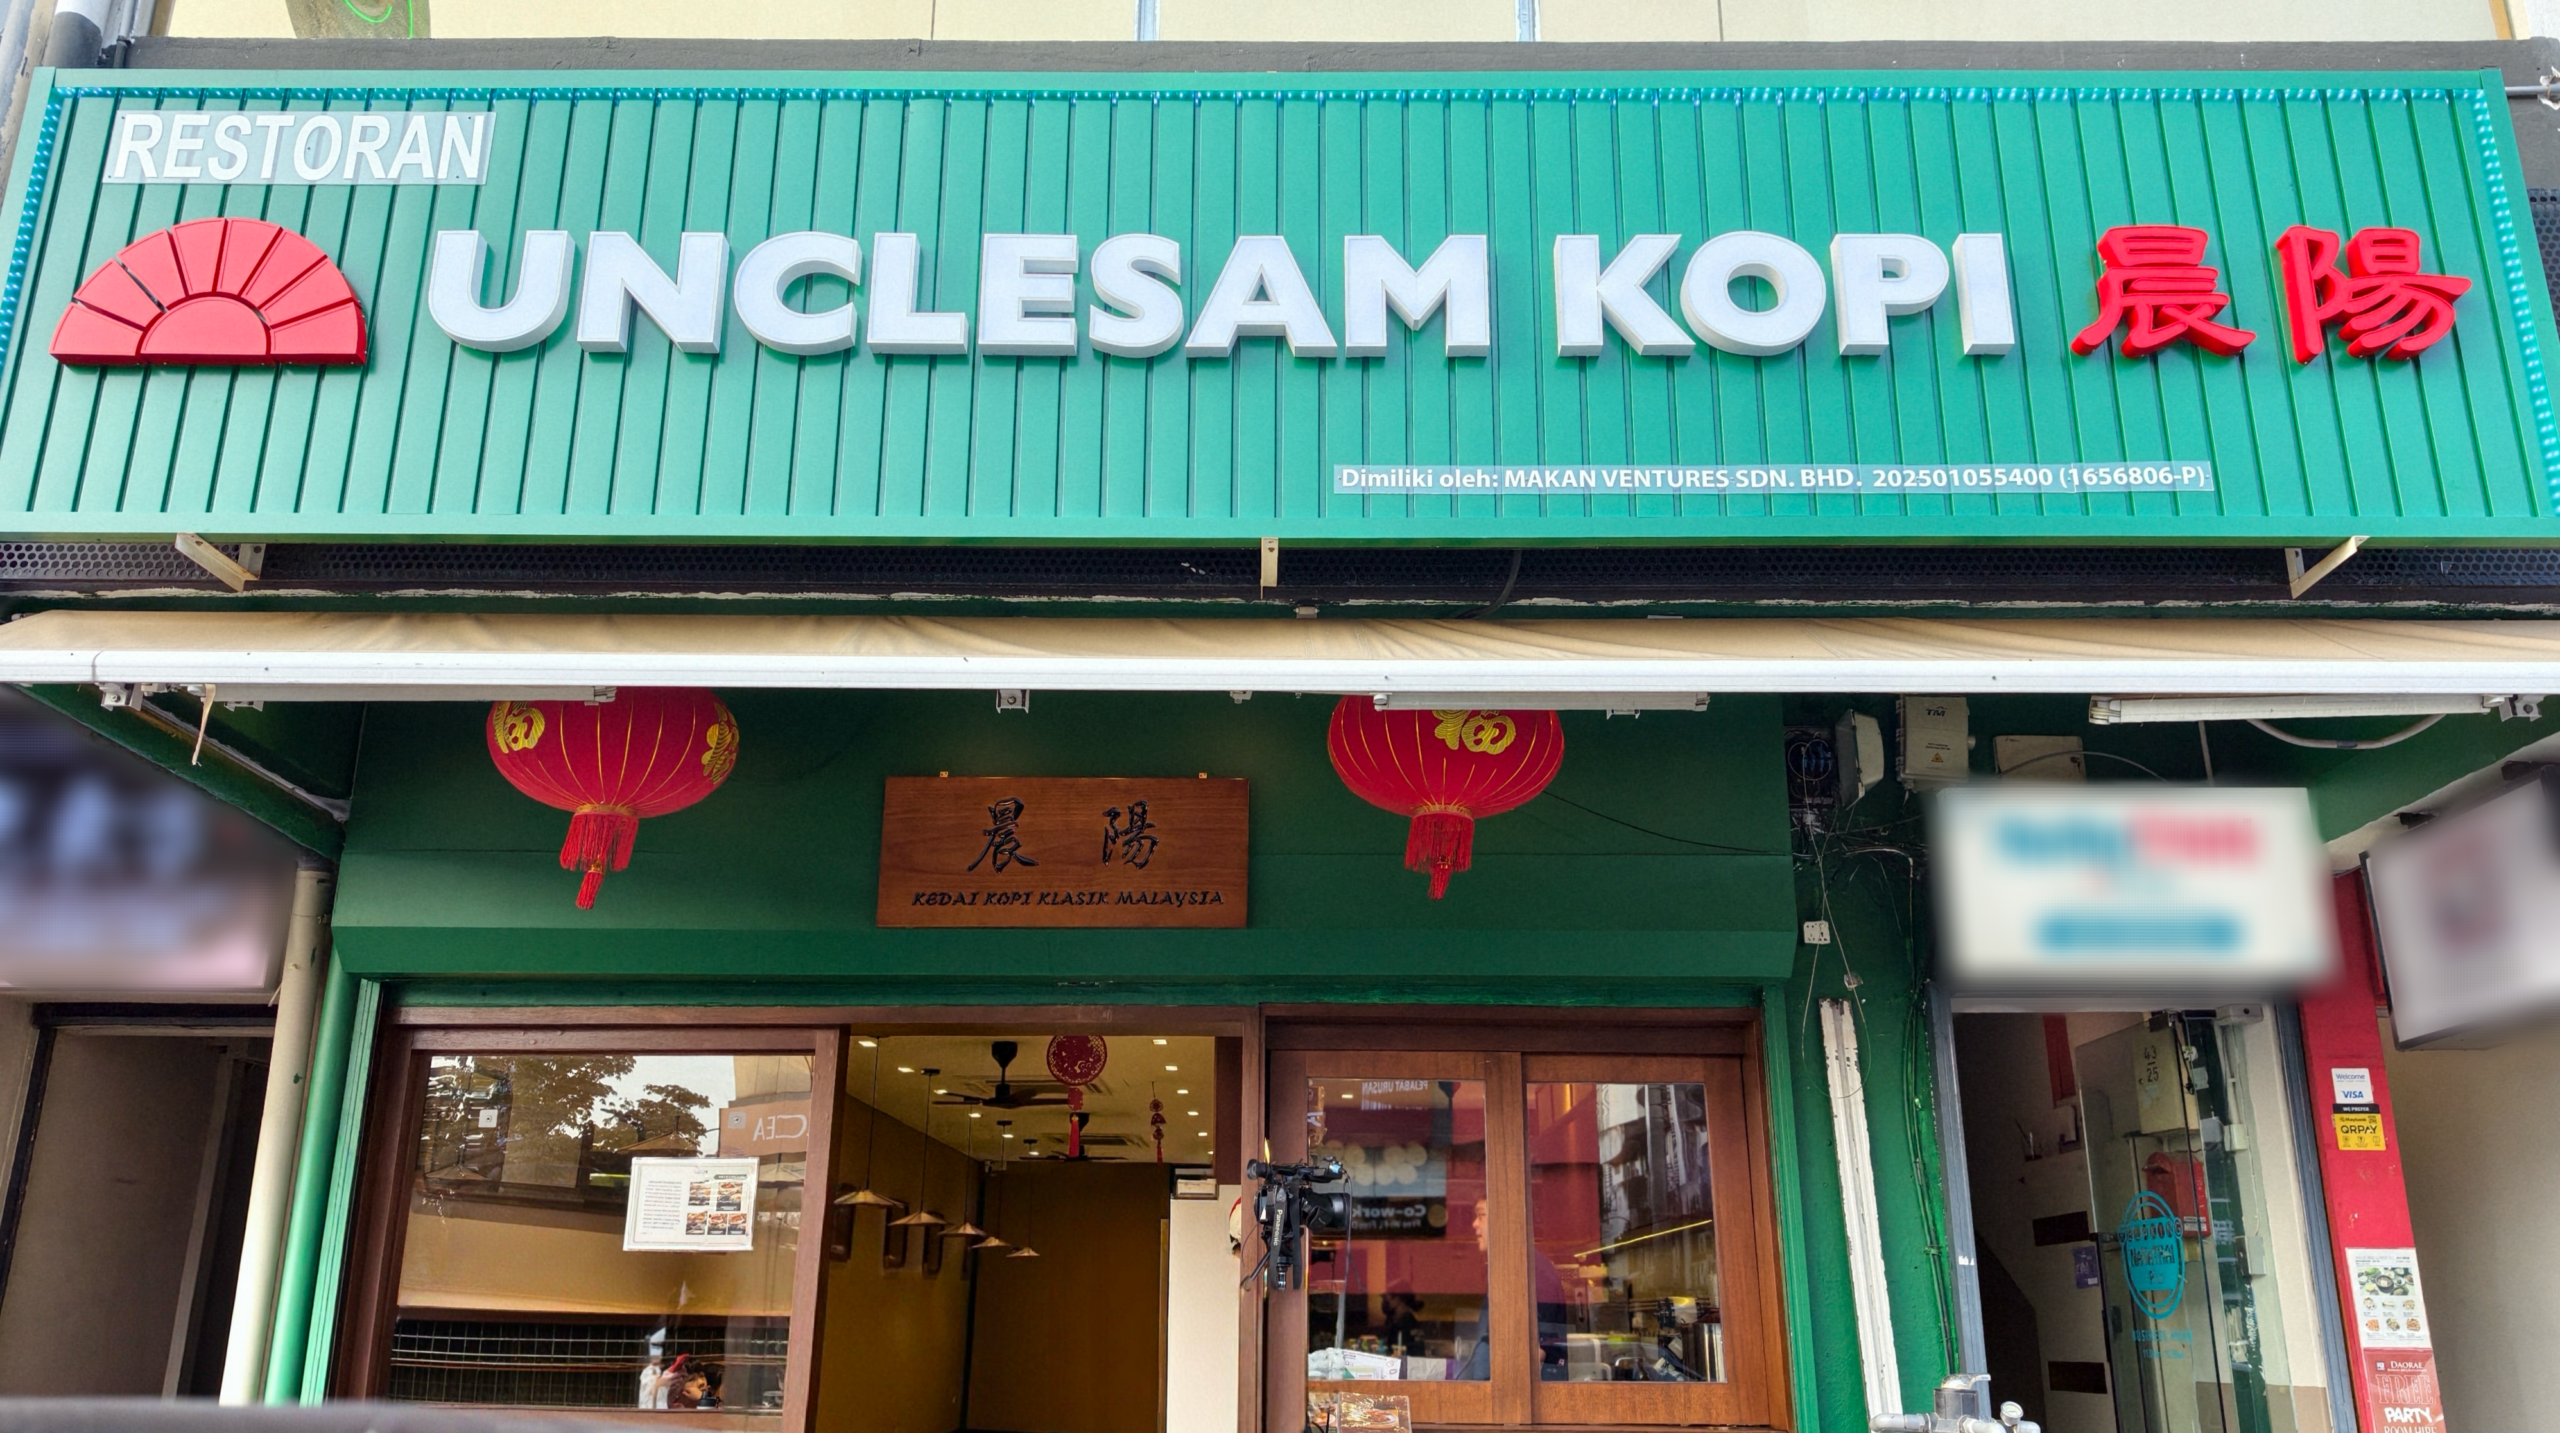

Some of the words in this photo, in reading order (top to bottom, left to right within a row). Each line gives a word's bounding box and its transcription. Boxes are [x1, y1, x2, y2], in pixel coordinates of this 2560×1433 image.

[113, 112, 485, 181] RESTORAN
[428, 229, 1490, 358] UNCLESAM
[1554, 230, 2016, 357] KOPI
[2071, 223, 2472, 364] 晨陽
[1341, 468, 1433, 489] Dimiliki
[1439, 468, 1499, 489] oleh:
[1504, 469, 1596, 489] MAKAN
[1601, 469, 1730, 489] VENTURES
[1735, 469, 1795, 488] SDN.
[1800, 468, 1863, 488] BHD.
[1872, 467, 2054, 488] 202501055400
[2059, 465, 2206, 488] (1656806-P)
[967, 797, 1159, 874] 晨陽
[983, 891, 1033, 906] KOPI
[1037, 891, 1109, 906] KLASIK
[1115, 890, 1225, 908] MALAYSIA
[2341, 1090, 2364, 1099] VISA
[2375, 1374, 2434, 1404] FREE
[2383, 1406, 2433, 1424] PARTY
